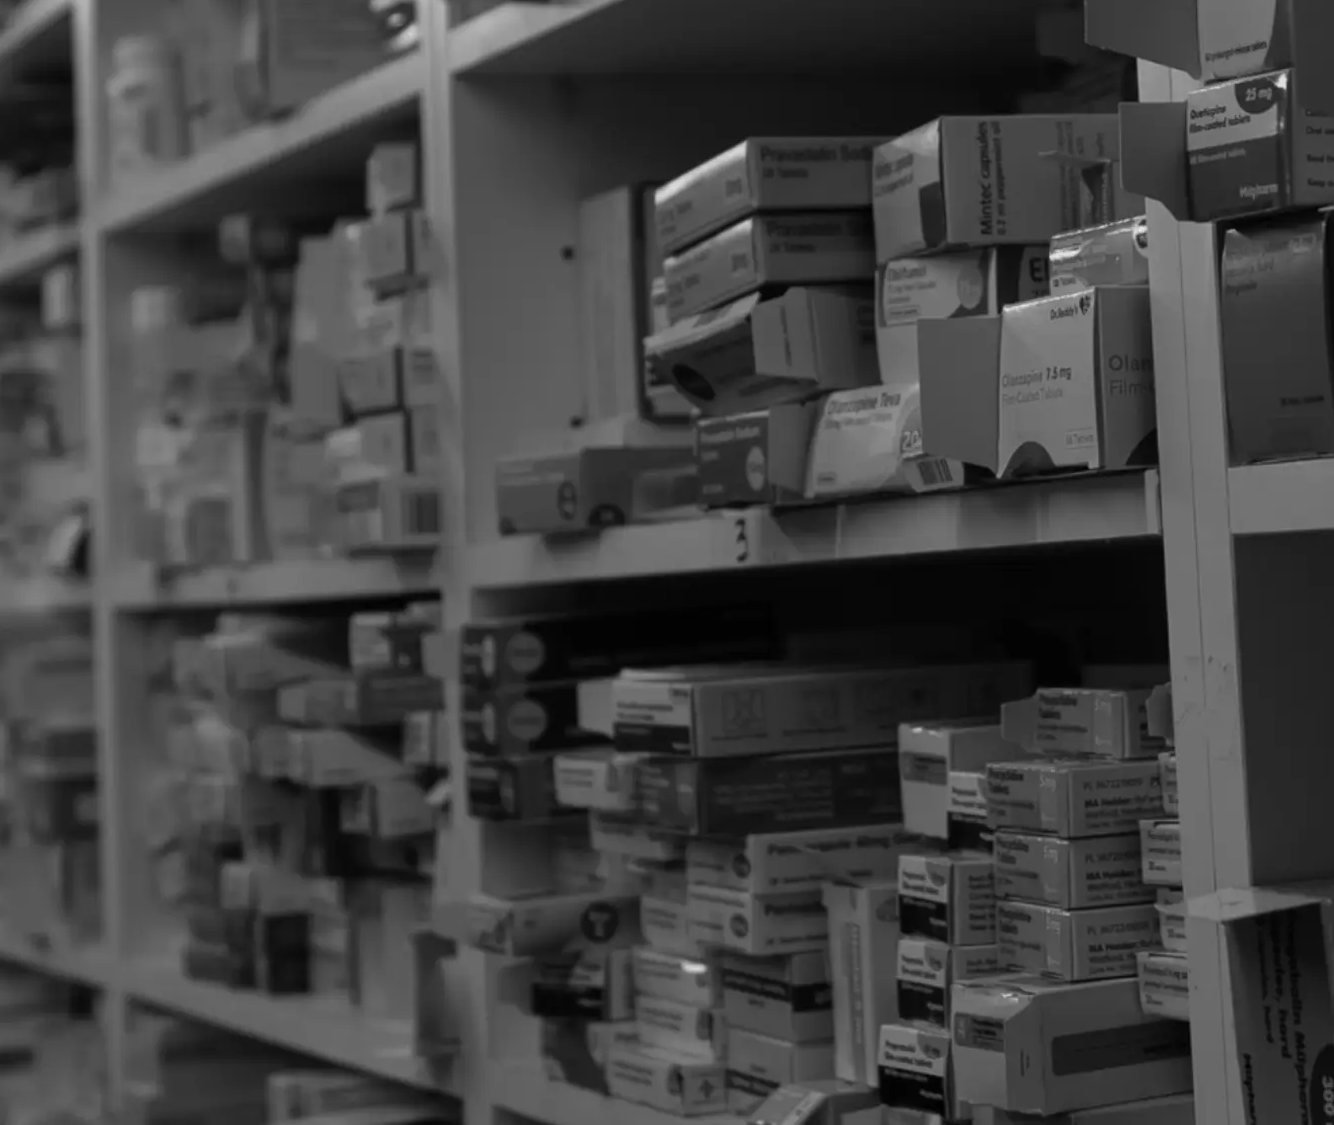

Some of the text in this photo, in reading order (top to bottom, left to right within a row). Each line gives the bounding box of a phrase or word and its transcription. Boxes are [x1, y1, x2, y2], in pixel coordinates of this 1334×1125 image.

[1245, 87, 1272, 102] 25 mg
[1190, 105, 1226, 120] Quetiapine
[1228, 114, 1251, 127] tablets
[1306, 126, 1322, 135] Oral
[1307, 153, 1324, 163] Read
[976, 121, 992, 236] Mintec capsules
[1307, 178, 1325, 189] Keep
[1002, 367, 1072, 388] Olanzapine 7.5 mg
[827, 391, 901, 416] Olanzapine Teva
[1085, 799, 1099, 808] MA
[1263, 1005, 1275, 1044] hard
[1277, 1009, 1293, 1059] hard
